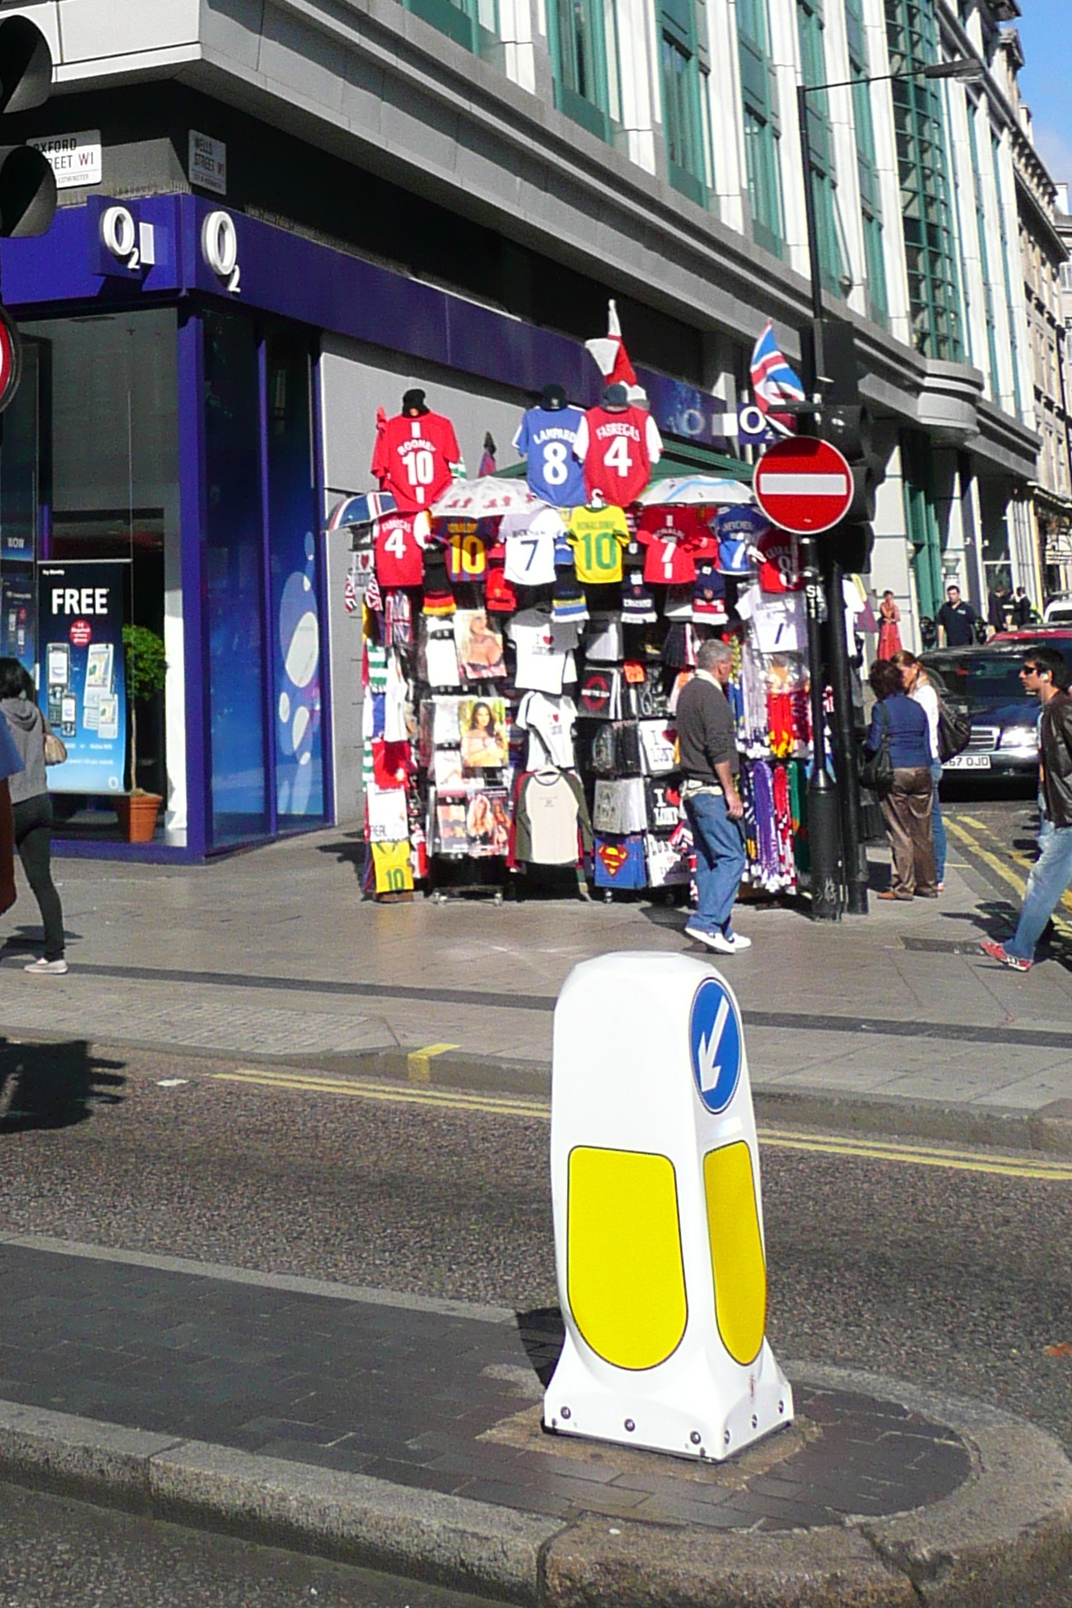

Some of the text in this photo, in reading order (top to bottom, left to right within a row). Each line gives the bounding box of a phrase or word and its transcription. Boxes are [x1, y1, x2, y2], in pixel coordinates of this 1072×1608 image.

[33, 138, 77, 154] OXFORD
[78, 152, 94, 166] W1
[402, 450, 435, 486] 10
[543, 442, 568, 485] 8
[603, 436, 633, 477] 4
[384, 528, 407, 560] 4
[449, 534, 486, 574] 10
[520, 539, 539, 572] 7
[580, 532, 617, 571] 10
[660, 535, 678, 563] 7
[52, 587, 109, 615] FREE
[386, 867, 405, 891] 10
